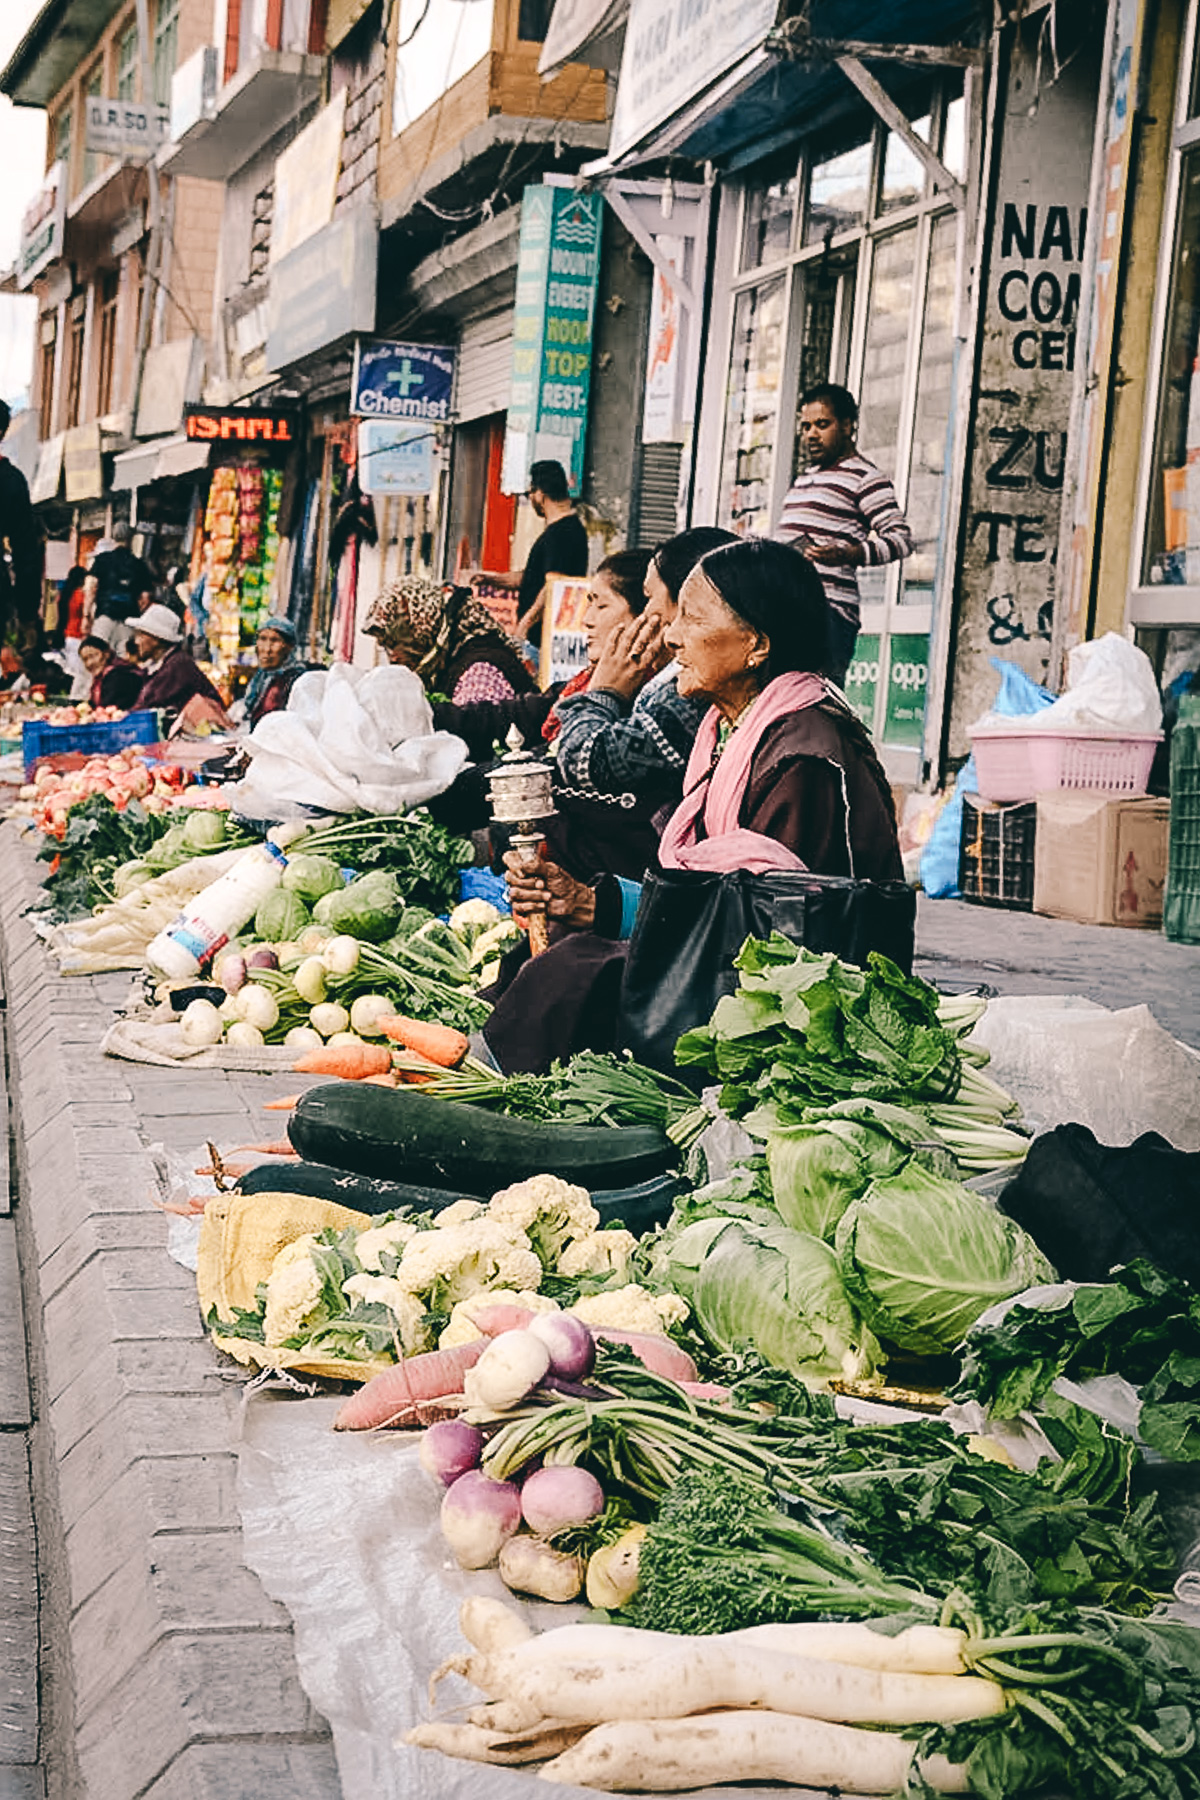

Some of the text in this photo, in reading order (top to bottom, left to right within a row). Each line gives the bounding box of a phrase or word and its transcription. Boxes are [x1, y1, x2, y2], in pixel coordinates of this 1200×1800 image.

[551, 248, 597, 276] MOUNT
[548, 282, 595, 309] EVEREST
[546, 349, 589, 377] TOP
[359, 389, 447, 418] Chemist
[542, 382, 586, 411] REST-
[970, 511, 1058, 563] TE
